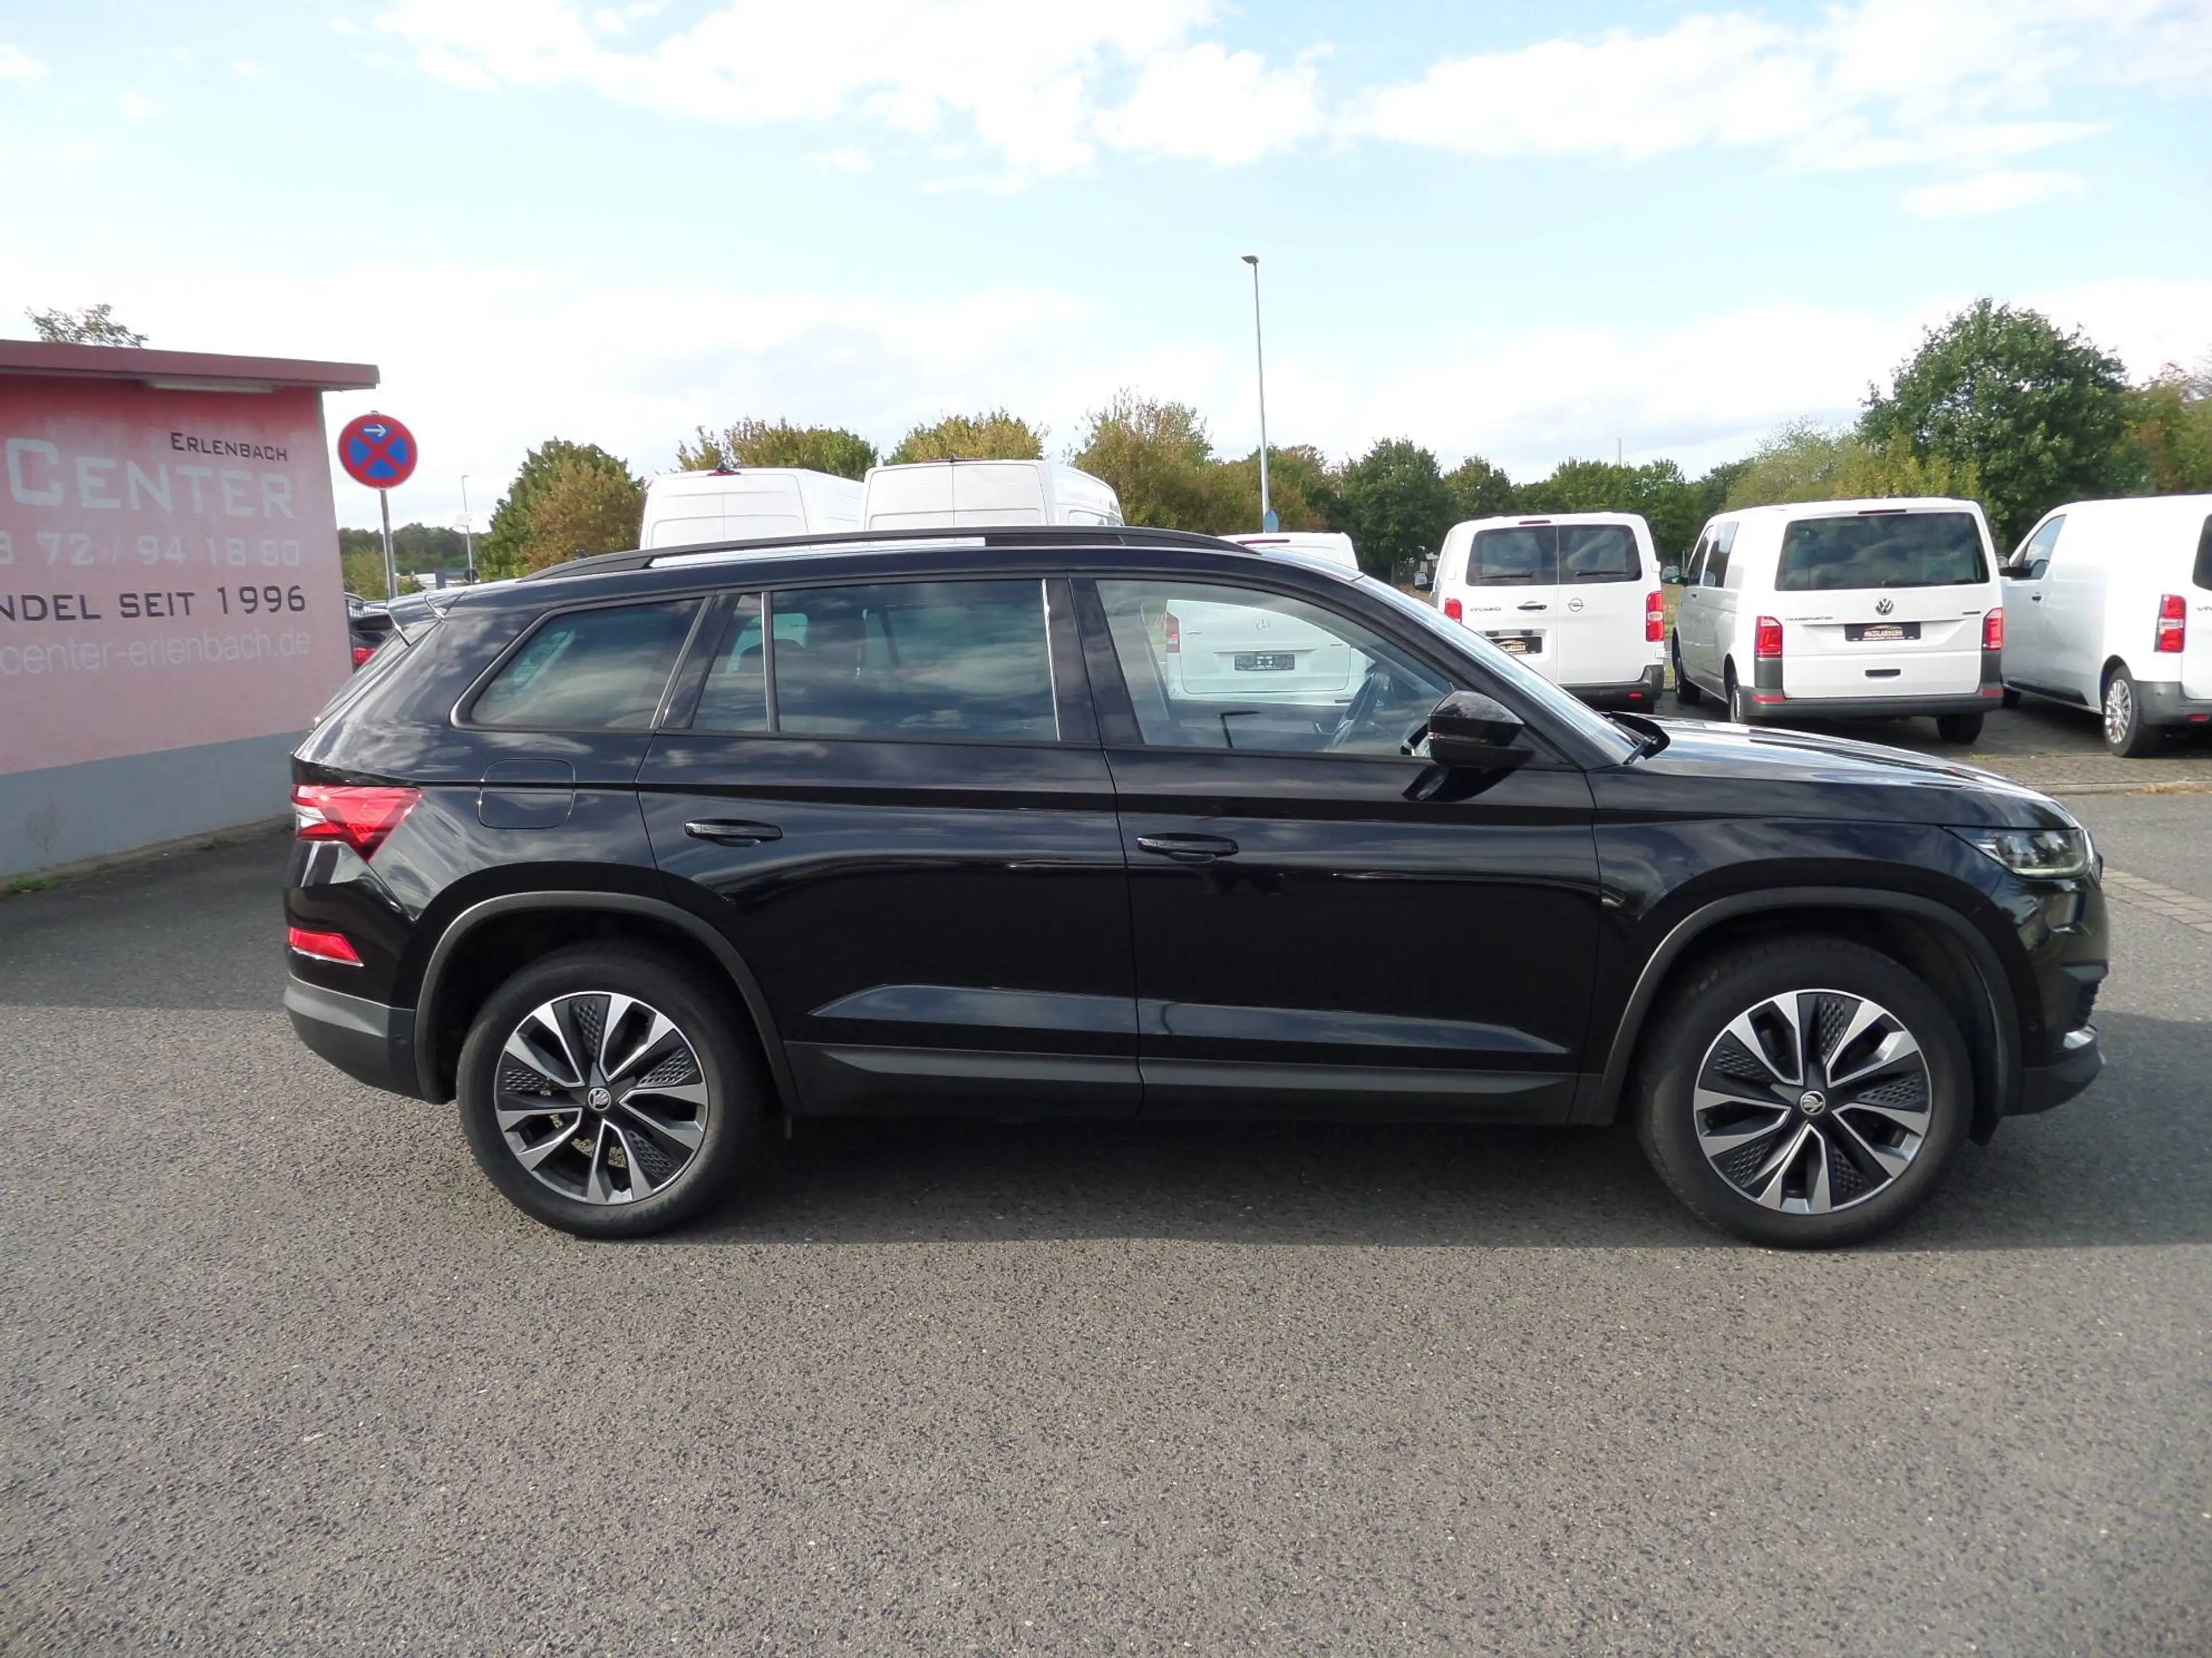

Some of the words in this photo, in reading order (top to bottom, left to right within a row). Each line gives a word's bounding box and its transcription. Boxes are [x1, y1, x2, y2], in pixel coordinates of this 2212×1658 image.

[171, 432, 287, 461] ERLENBACH
[5, 438, 294, 518] CENTER
[36, 532, 94, 566] 72
[137, 534, 187, 566] 94
[206, 537, 246, 566] 18
[119, 593, 195, 618] SEIT
[217, 585, 306, 615] 1996
